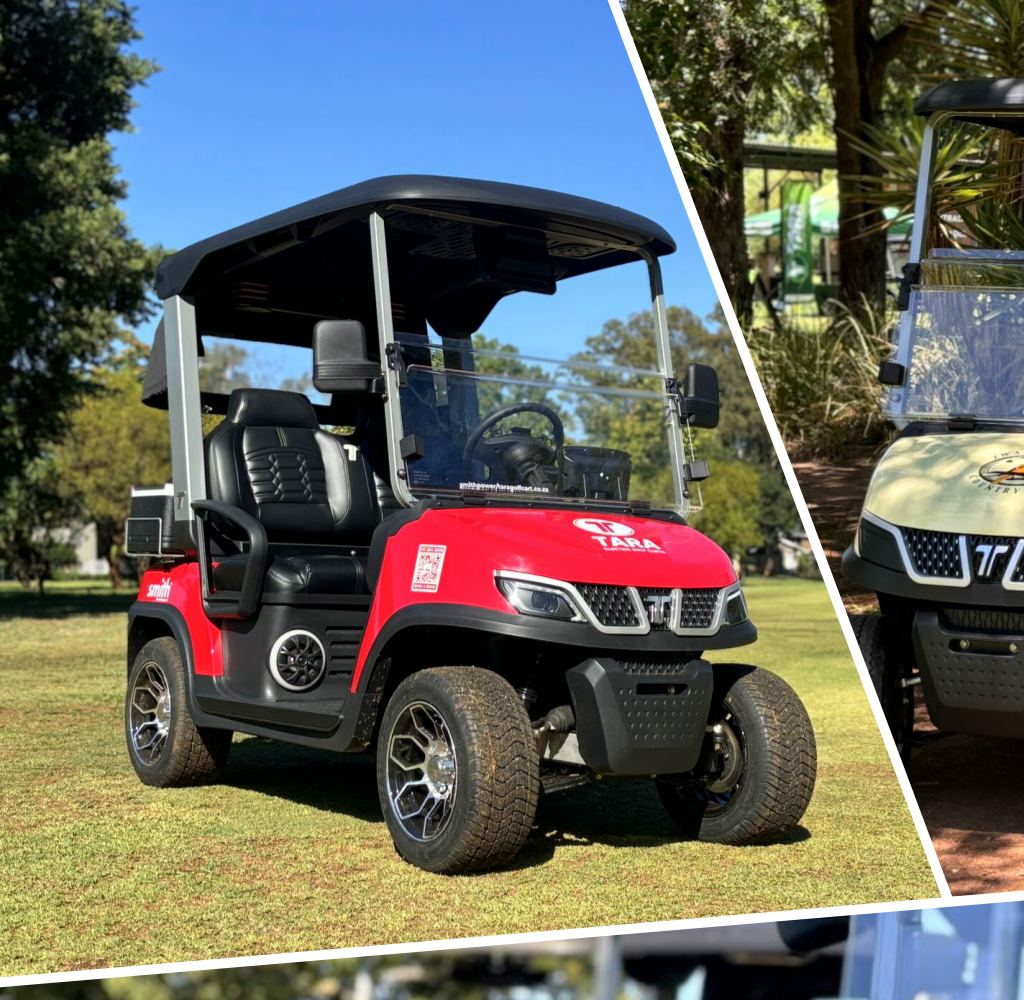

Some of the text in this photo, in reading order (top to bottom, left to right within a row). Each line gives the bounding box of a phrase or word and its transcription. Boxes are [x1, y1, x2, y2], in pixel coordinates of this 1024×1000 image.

[459, 481, 549, 493] smithpower/taragolfcart.co.za
[591, 535, 661, 550] TARA
[147, 578, 171, 597] smith
